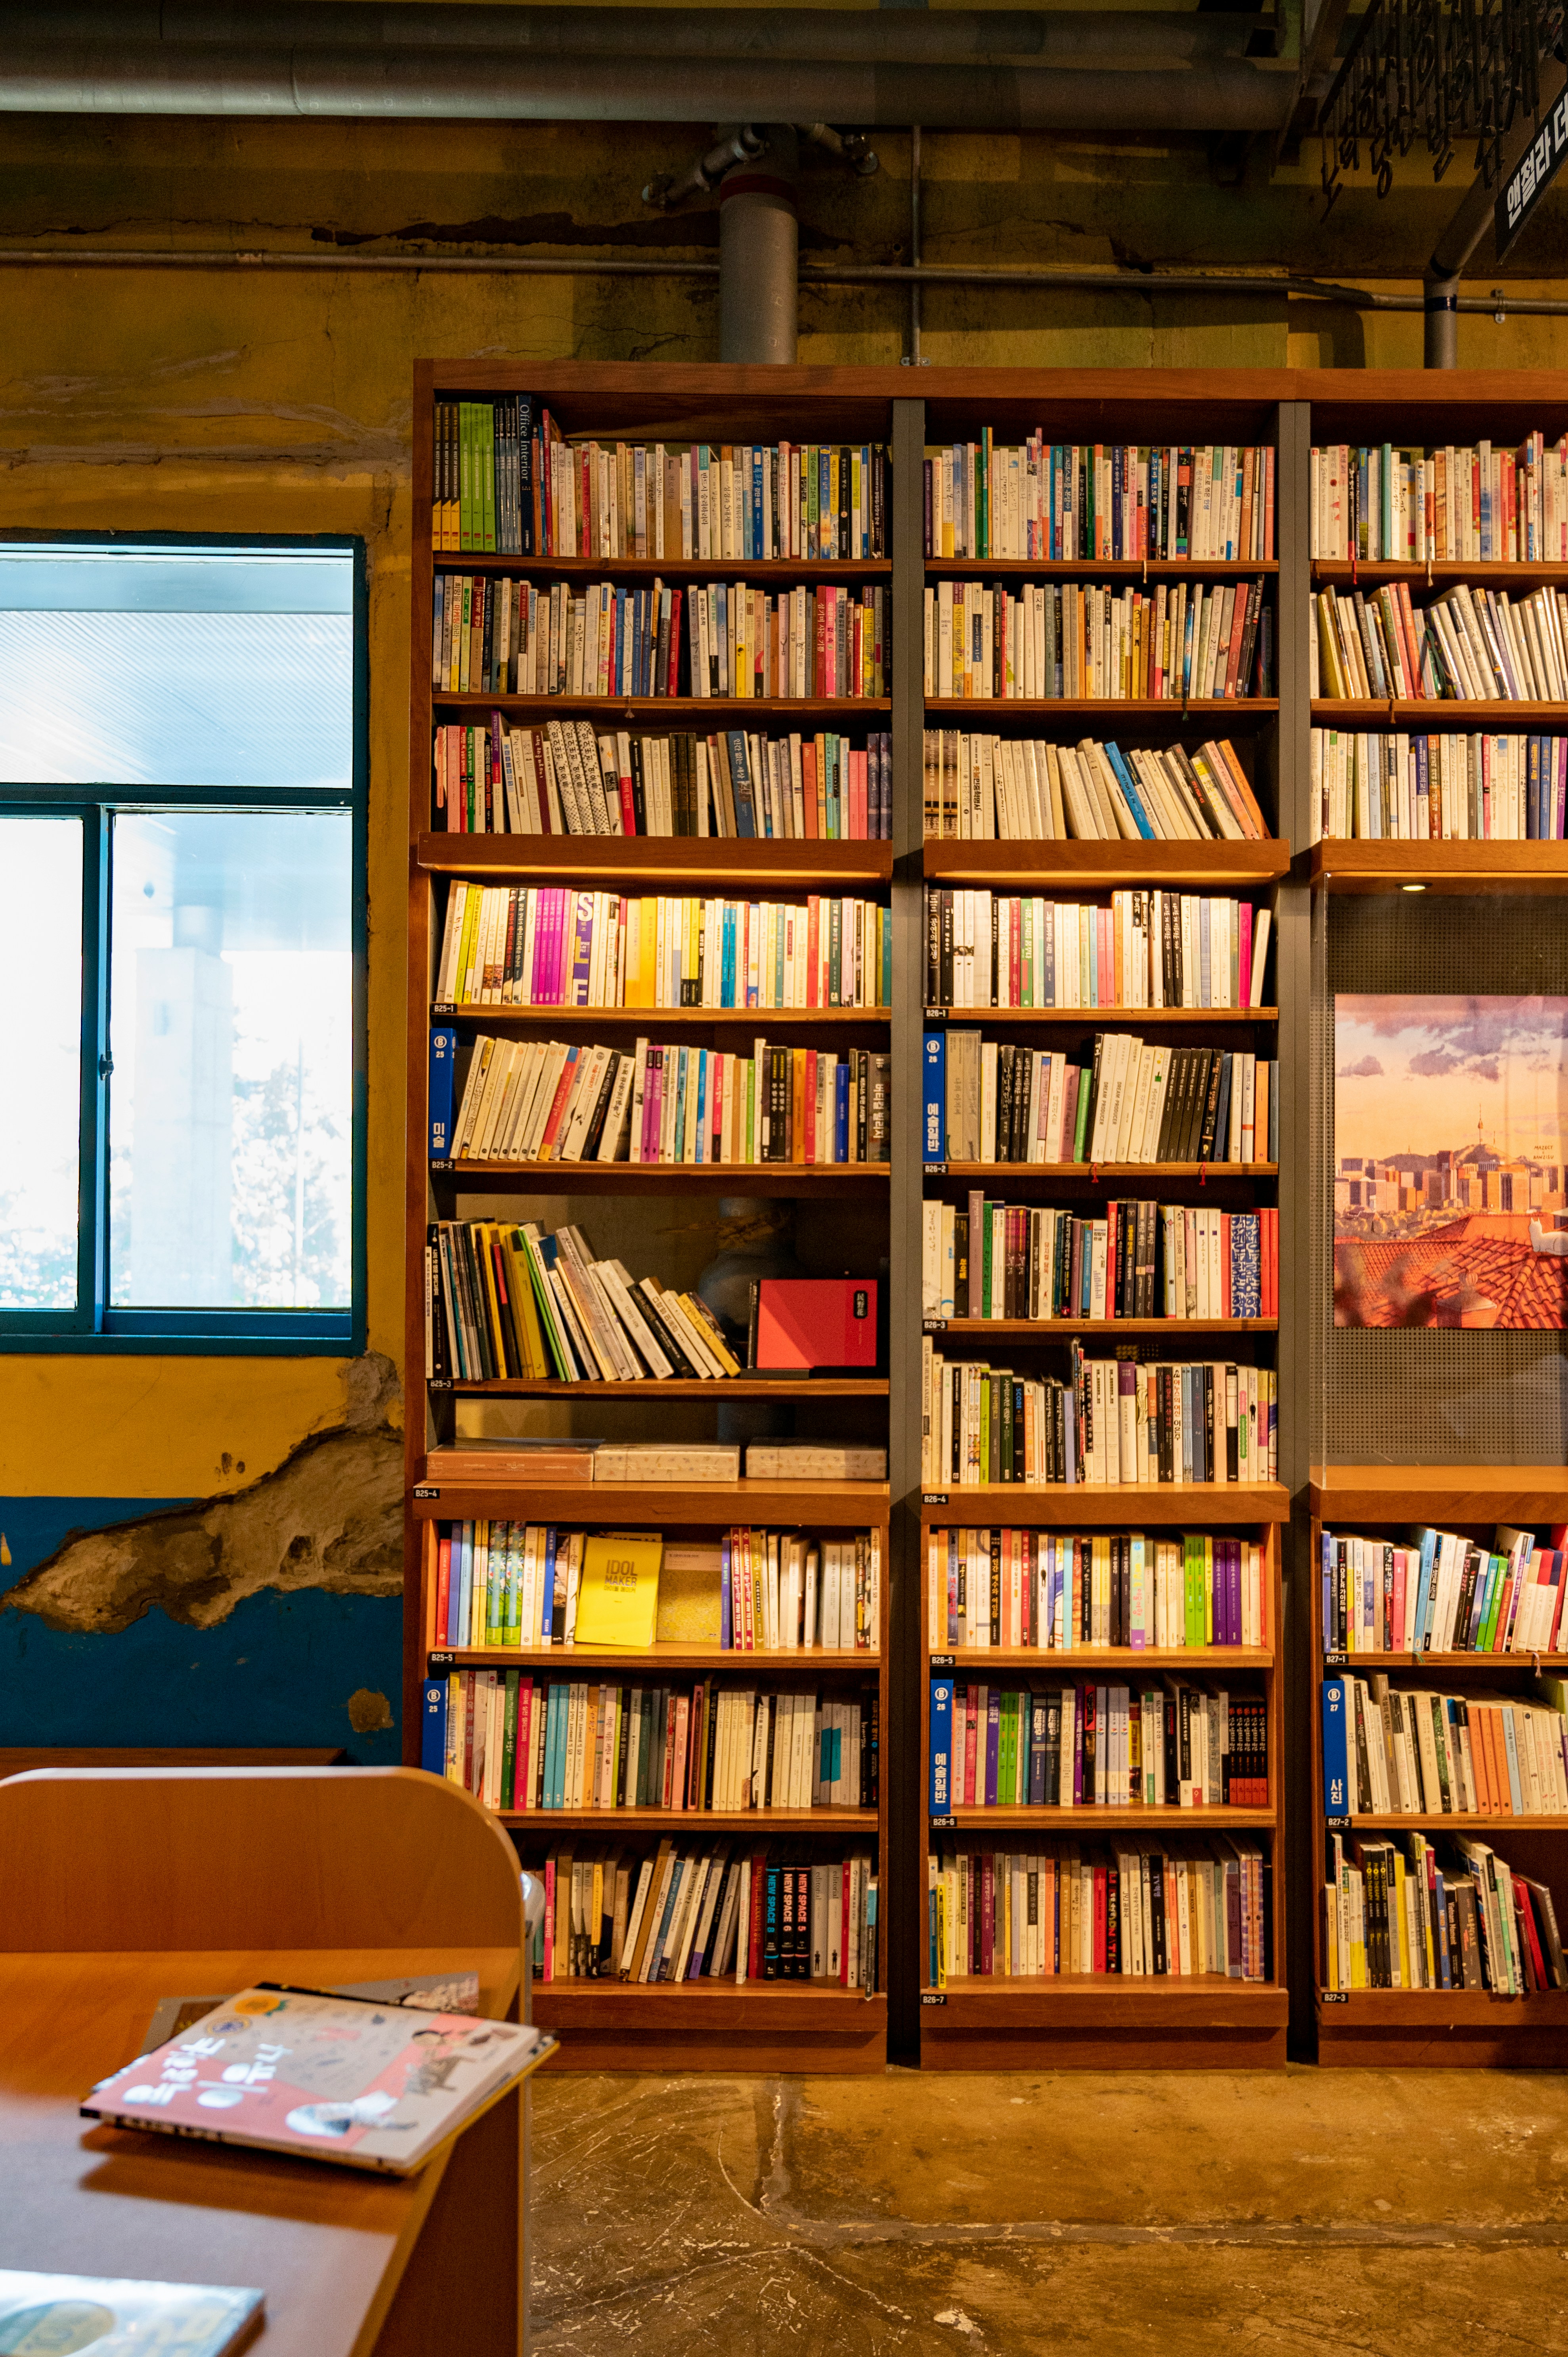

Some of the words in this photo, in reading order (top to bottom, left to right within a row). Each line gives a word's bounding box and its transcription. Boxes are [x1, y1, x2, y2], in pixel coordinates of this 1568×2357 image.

[520, 404, 530, 436] Office
[521, 440, 530, 480] Interior
[873, 1083, 884, 1110] 버티컬
[433, 1123, 445, 1148] 미술
[873, 1112, 884, 1138] 빌리지
[927, 1103, 939, 1152] 예술일반
[604, 1575, 637, 1586] MAKER
[606, 1559, 638, 1576] IDOL
[519, 1745, 528, 1779] calligraphy
[935, 1753, 947, 1804] 예술일반
[1330, 1779, 1342, 1804] 사진
[767, 1875, 776, 1894] NEW
[784, 1873, 792, 1893] NEW
[798, 1873, 807, 1893] NEW
[767, 1896, 775, 1923] SPACE
[783, 1895, 792, 1922] SPACE
[797, 1895, 806, 1922] SPACE
